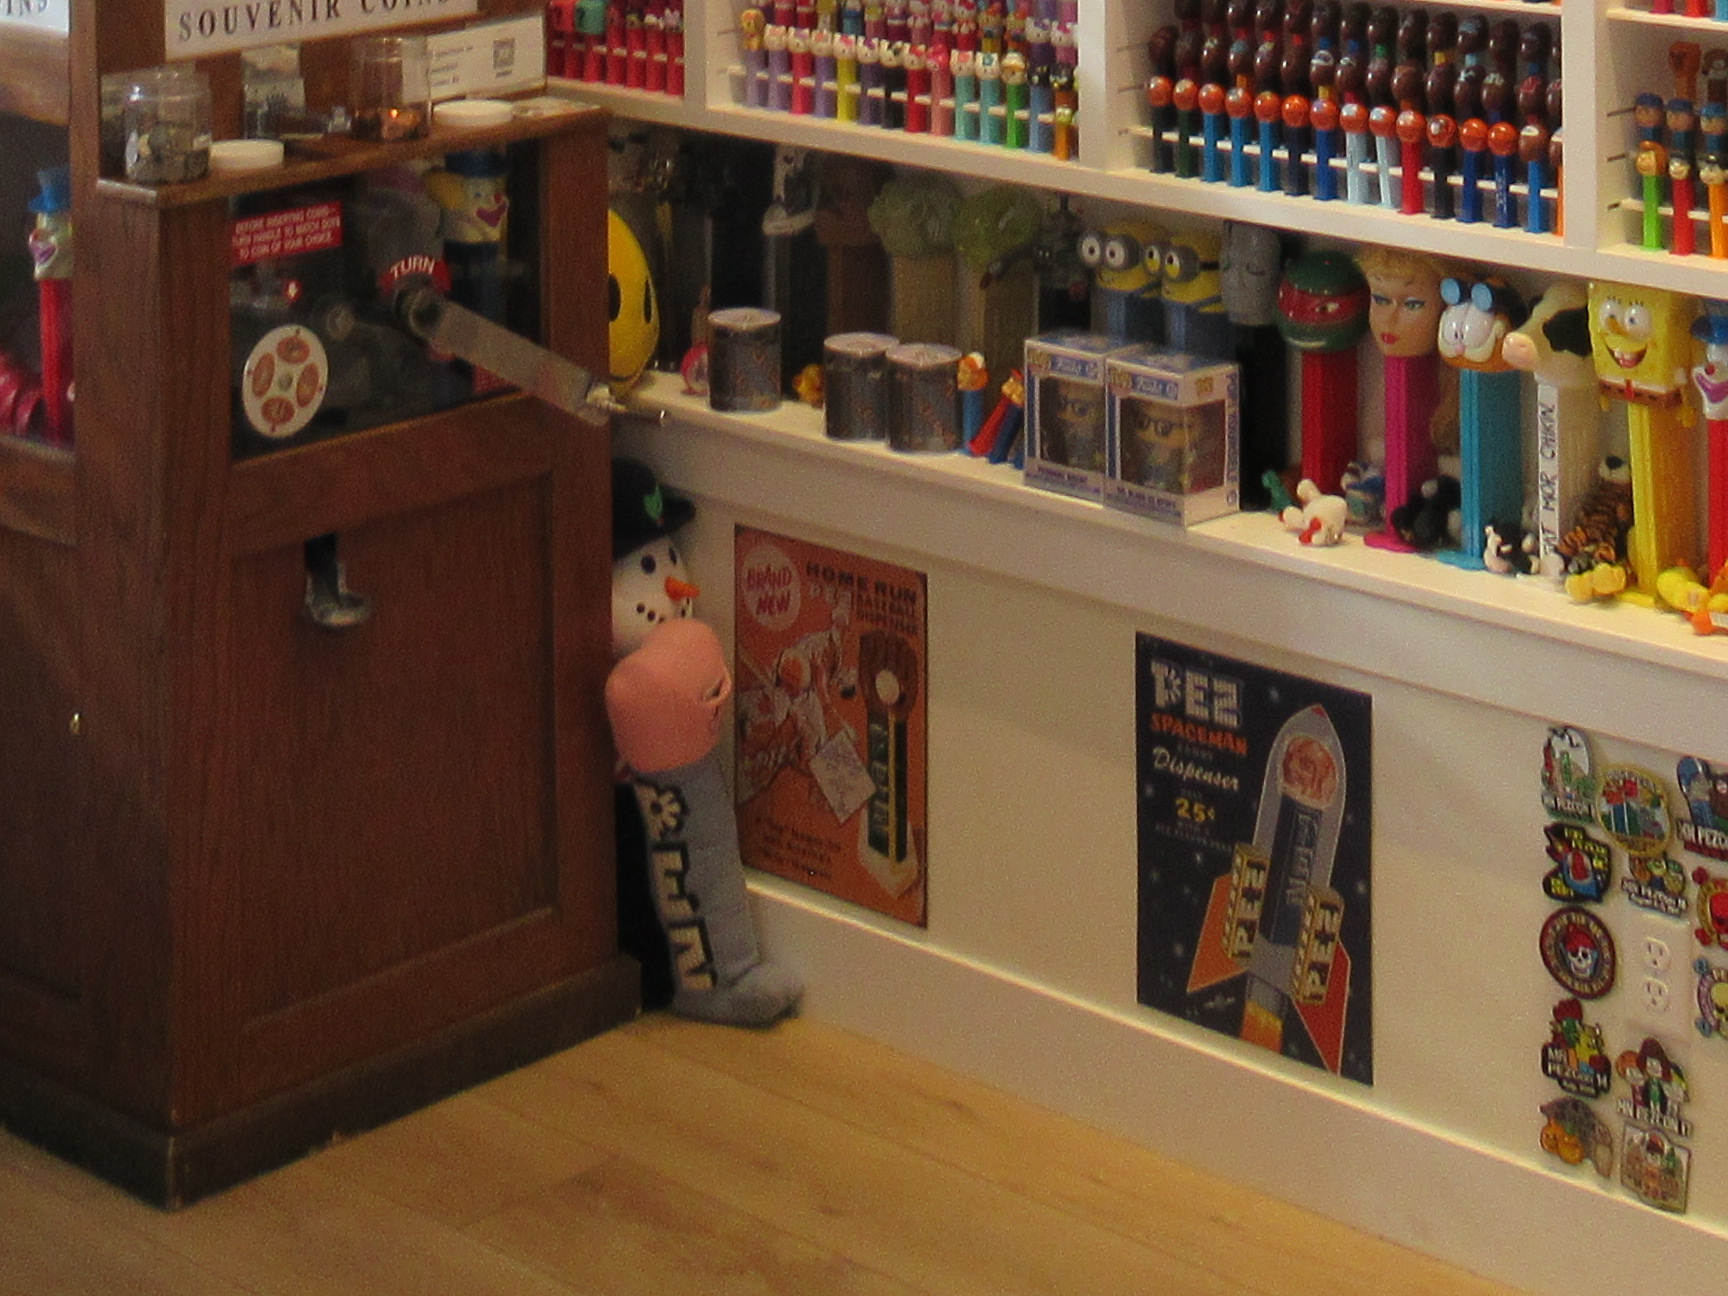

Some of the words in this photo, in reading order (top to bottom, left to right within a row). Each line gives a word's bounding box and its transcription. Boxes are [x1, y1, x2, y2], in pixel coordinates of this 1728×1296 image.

[390, 254, 436, 280] TURN
[747, 564, 792, 592] BRAND
[806, 561, 868, 591] HOME
[875, 580, 917, 605] RUN
[756, 588, 791, 616] NEW
[1151, 660, 1242, 729] PEZ
[1151, 711, 1249, 756] SPACEMAN
[1152, 745, 1240, 792] Dispenser
